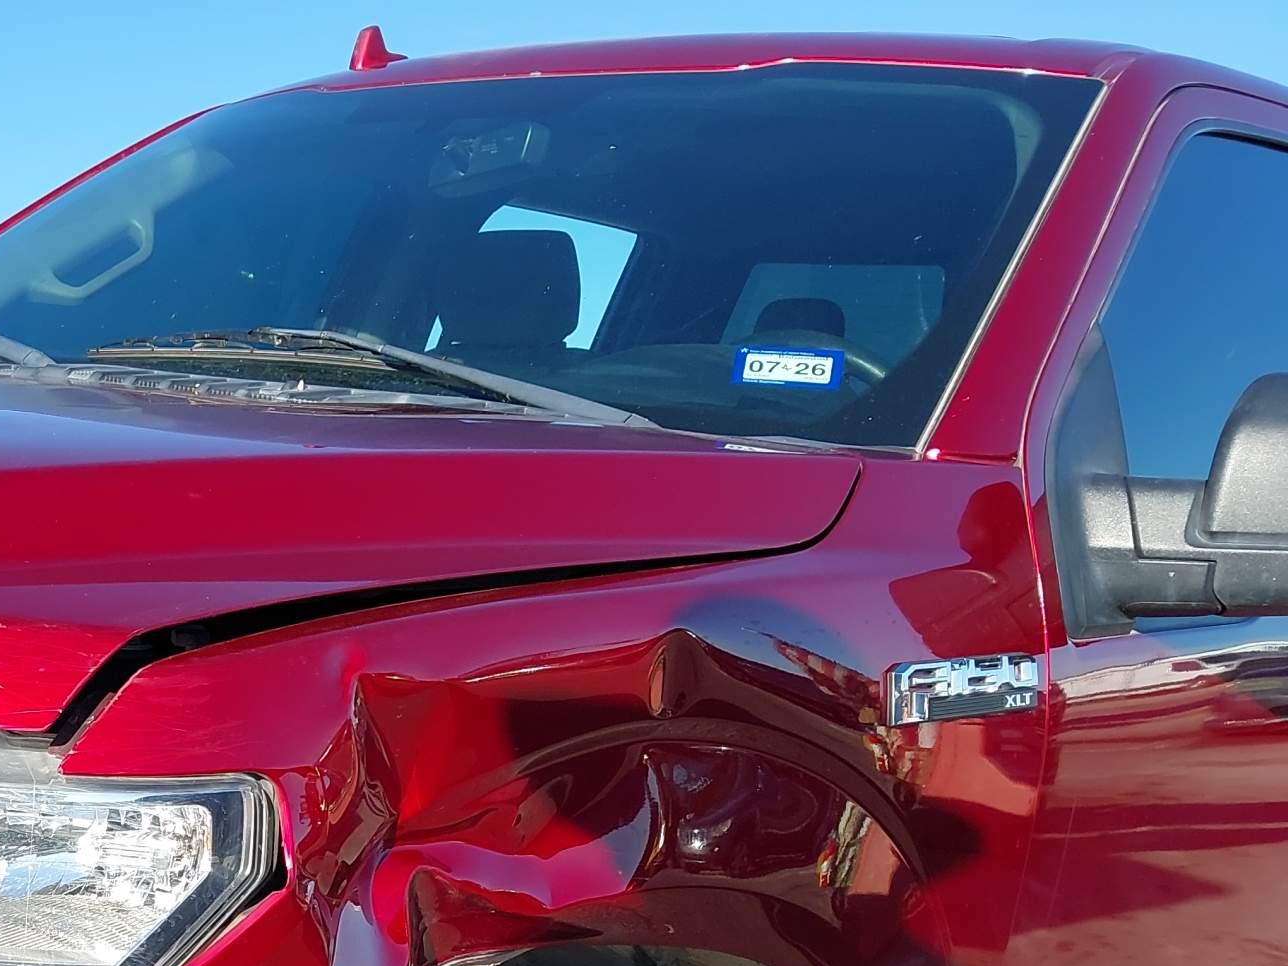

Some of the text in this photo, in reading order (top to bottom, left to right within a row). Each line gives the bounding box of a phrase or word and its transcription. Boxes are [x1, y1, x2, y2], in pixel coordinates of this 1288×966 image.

[748, 359, 827, 377] 07 26
[1004, 692, 1033, 708] XLT
